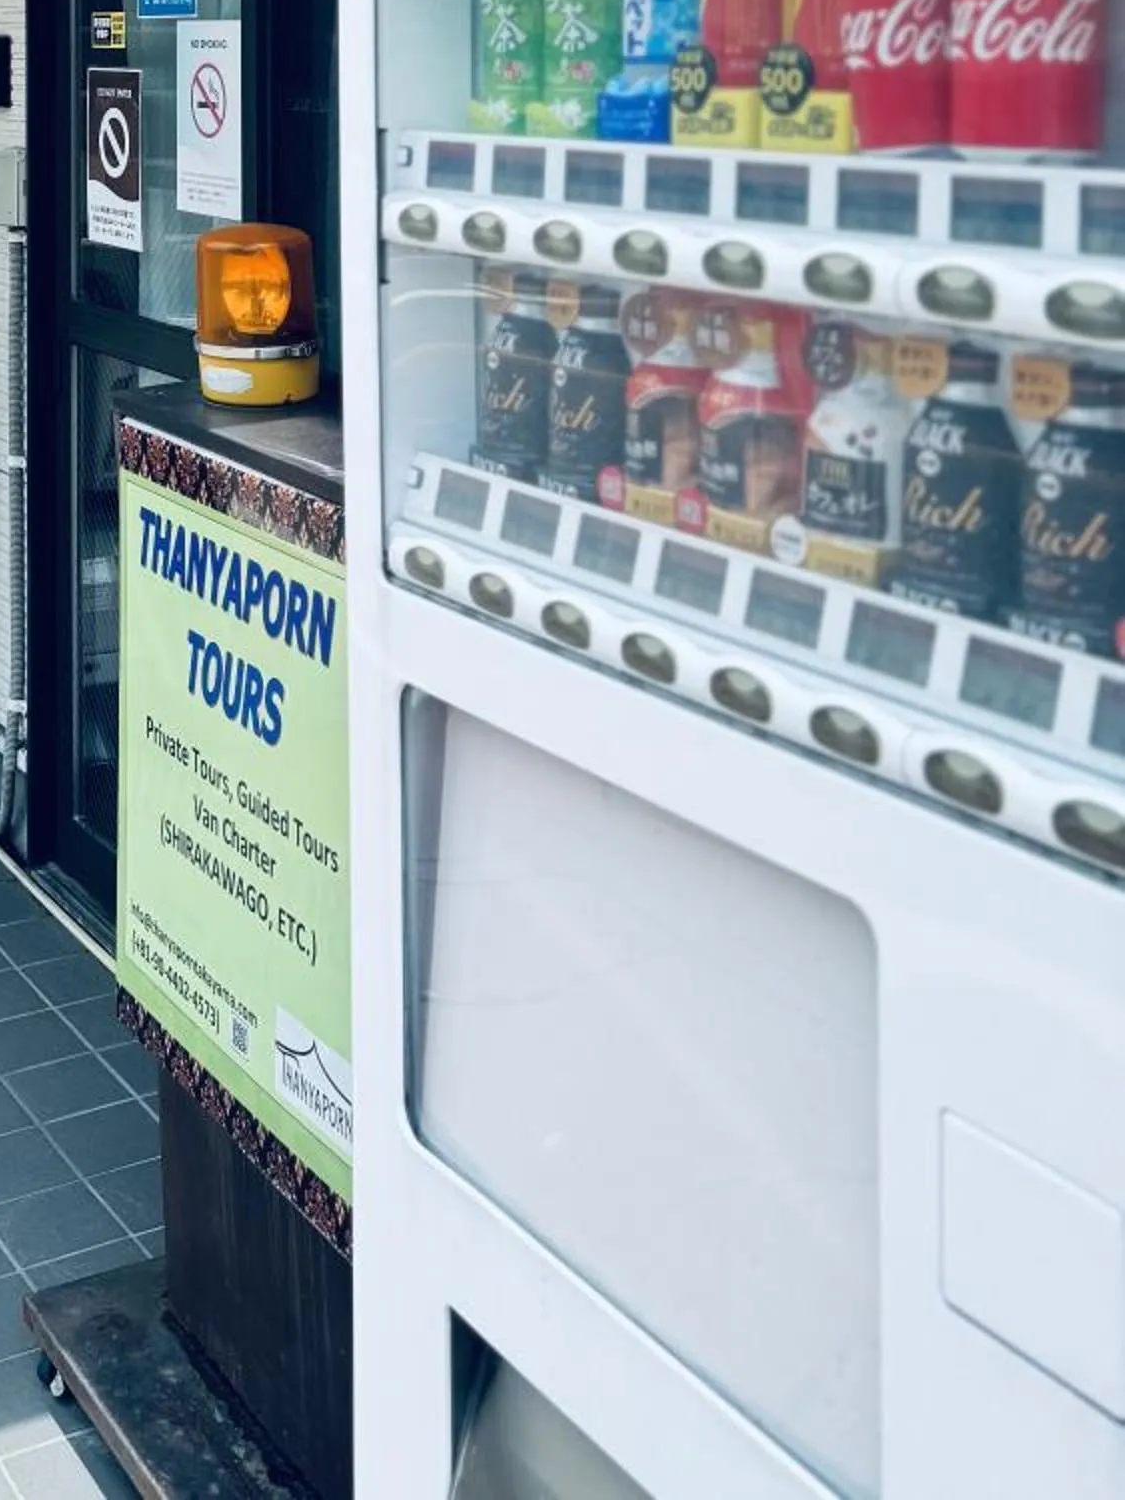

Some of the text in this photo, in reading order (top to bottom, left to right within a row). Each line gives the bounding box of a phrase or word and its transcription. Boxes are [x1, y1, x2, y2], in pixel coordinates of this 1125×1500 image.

[760, 66, 805, 96] 500
[906, 474, 984, 533] Rich
[1022, 499, 1111, 563] Rich
[139, 505, 336, 669] THANYAPORN
[187, 628, 286, 747] TOURS
[145, 714, 340, 873] Private Tours, Guided Tours
[193, 794, 277, 879] Van Charter
[160, 812, 317, 968] (SHIRAKAWAGO, ETC.)
